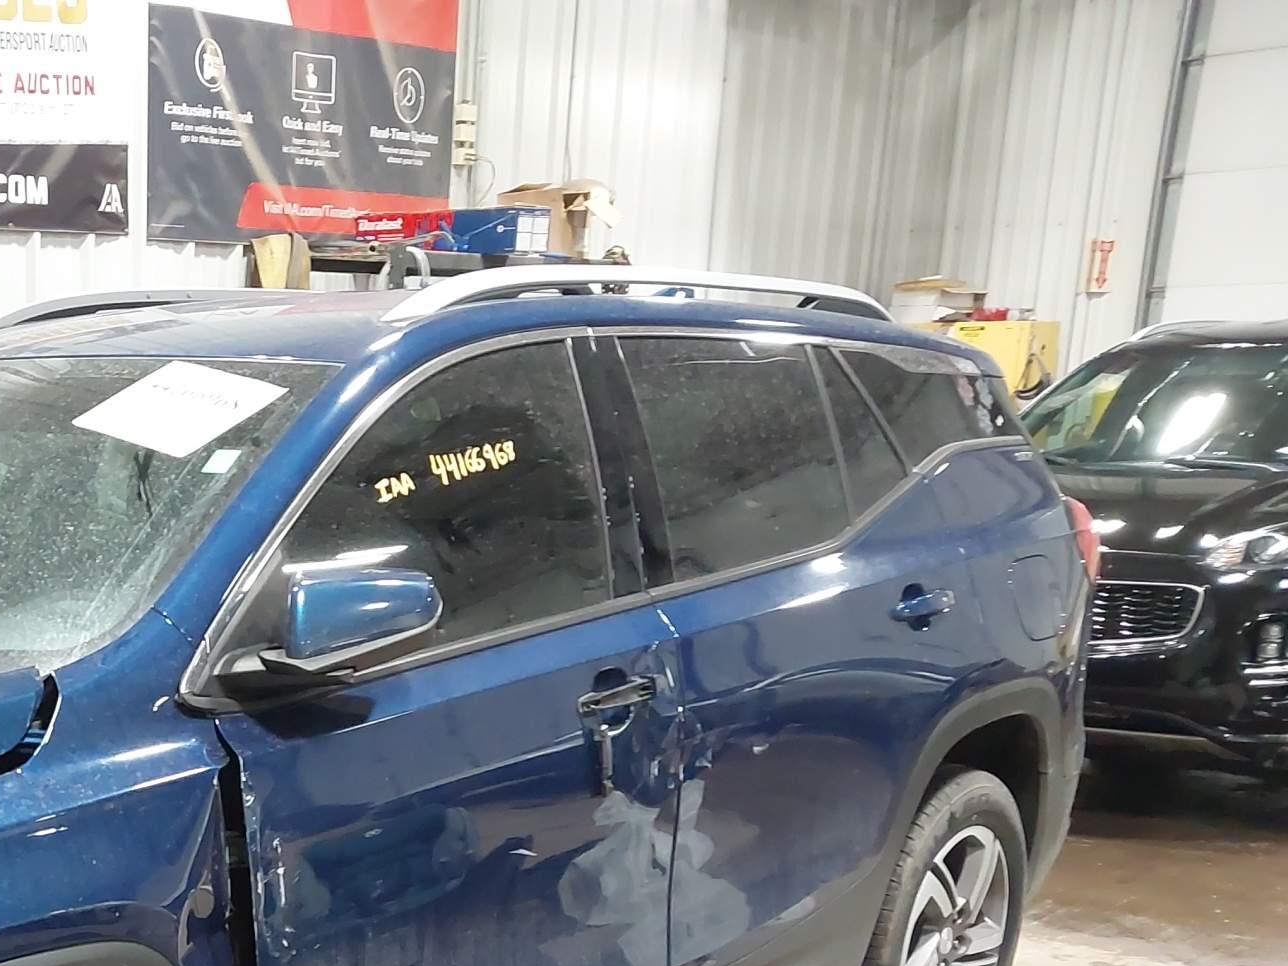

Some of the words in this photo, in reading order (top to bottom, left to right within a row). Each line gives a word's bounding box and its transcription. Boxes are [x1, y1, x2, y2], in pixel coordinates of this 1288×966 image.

[48, 33, 89, 53] AUCTION
[13, 72, 96, 96] AUCTION
[163, 101, 212, 118] Exclusive
[282, 115, 304, 131] Quick
[304, 120, 322, 132] and
[322, 120, 344, 137] Easy
[369, 125, 410, 142] Real-Time
[373, 472, 417, 504] IAA
